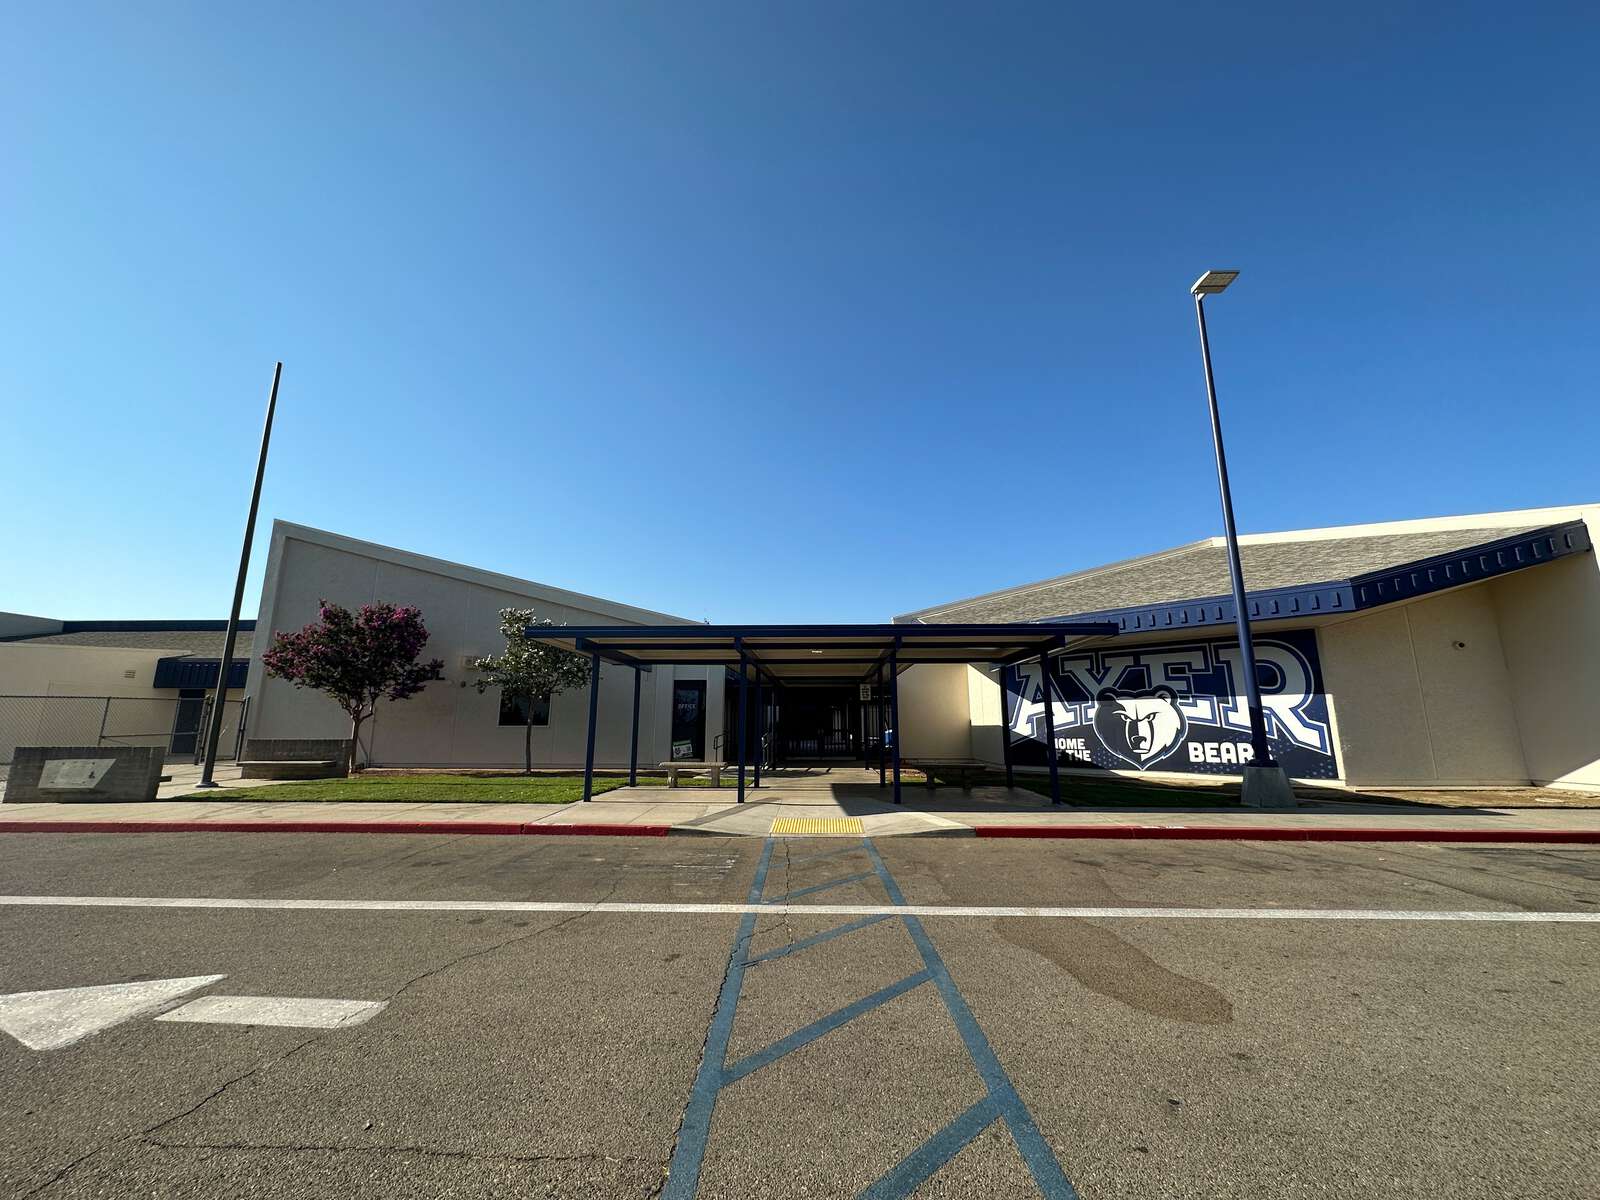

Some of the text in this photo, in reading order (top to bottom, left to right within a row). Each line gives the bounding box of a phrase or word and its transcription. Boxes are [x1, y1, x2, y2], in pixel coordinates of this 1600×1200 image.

[1010, 640, 1331, 756] AYER
[1065, 749, 1092, 761] THE
[1187, 741, 1274, 764] BEAR
